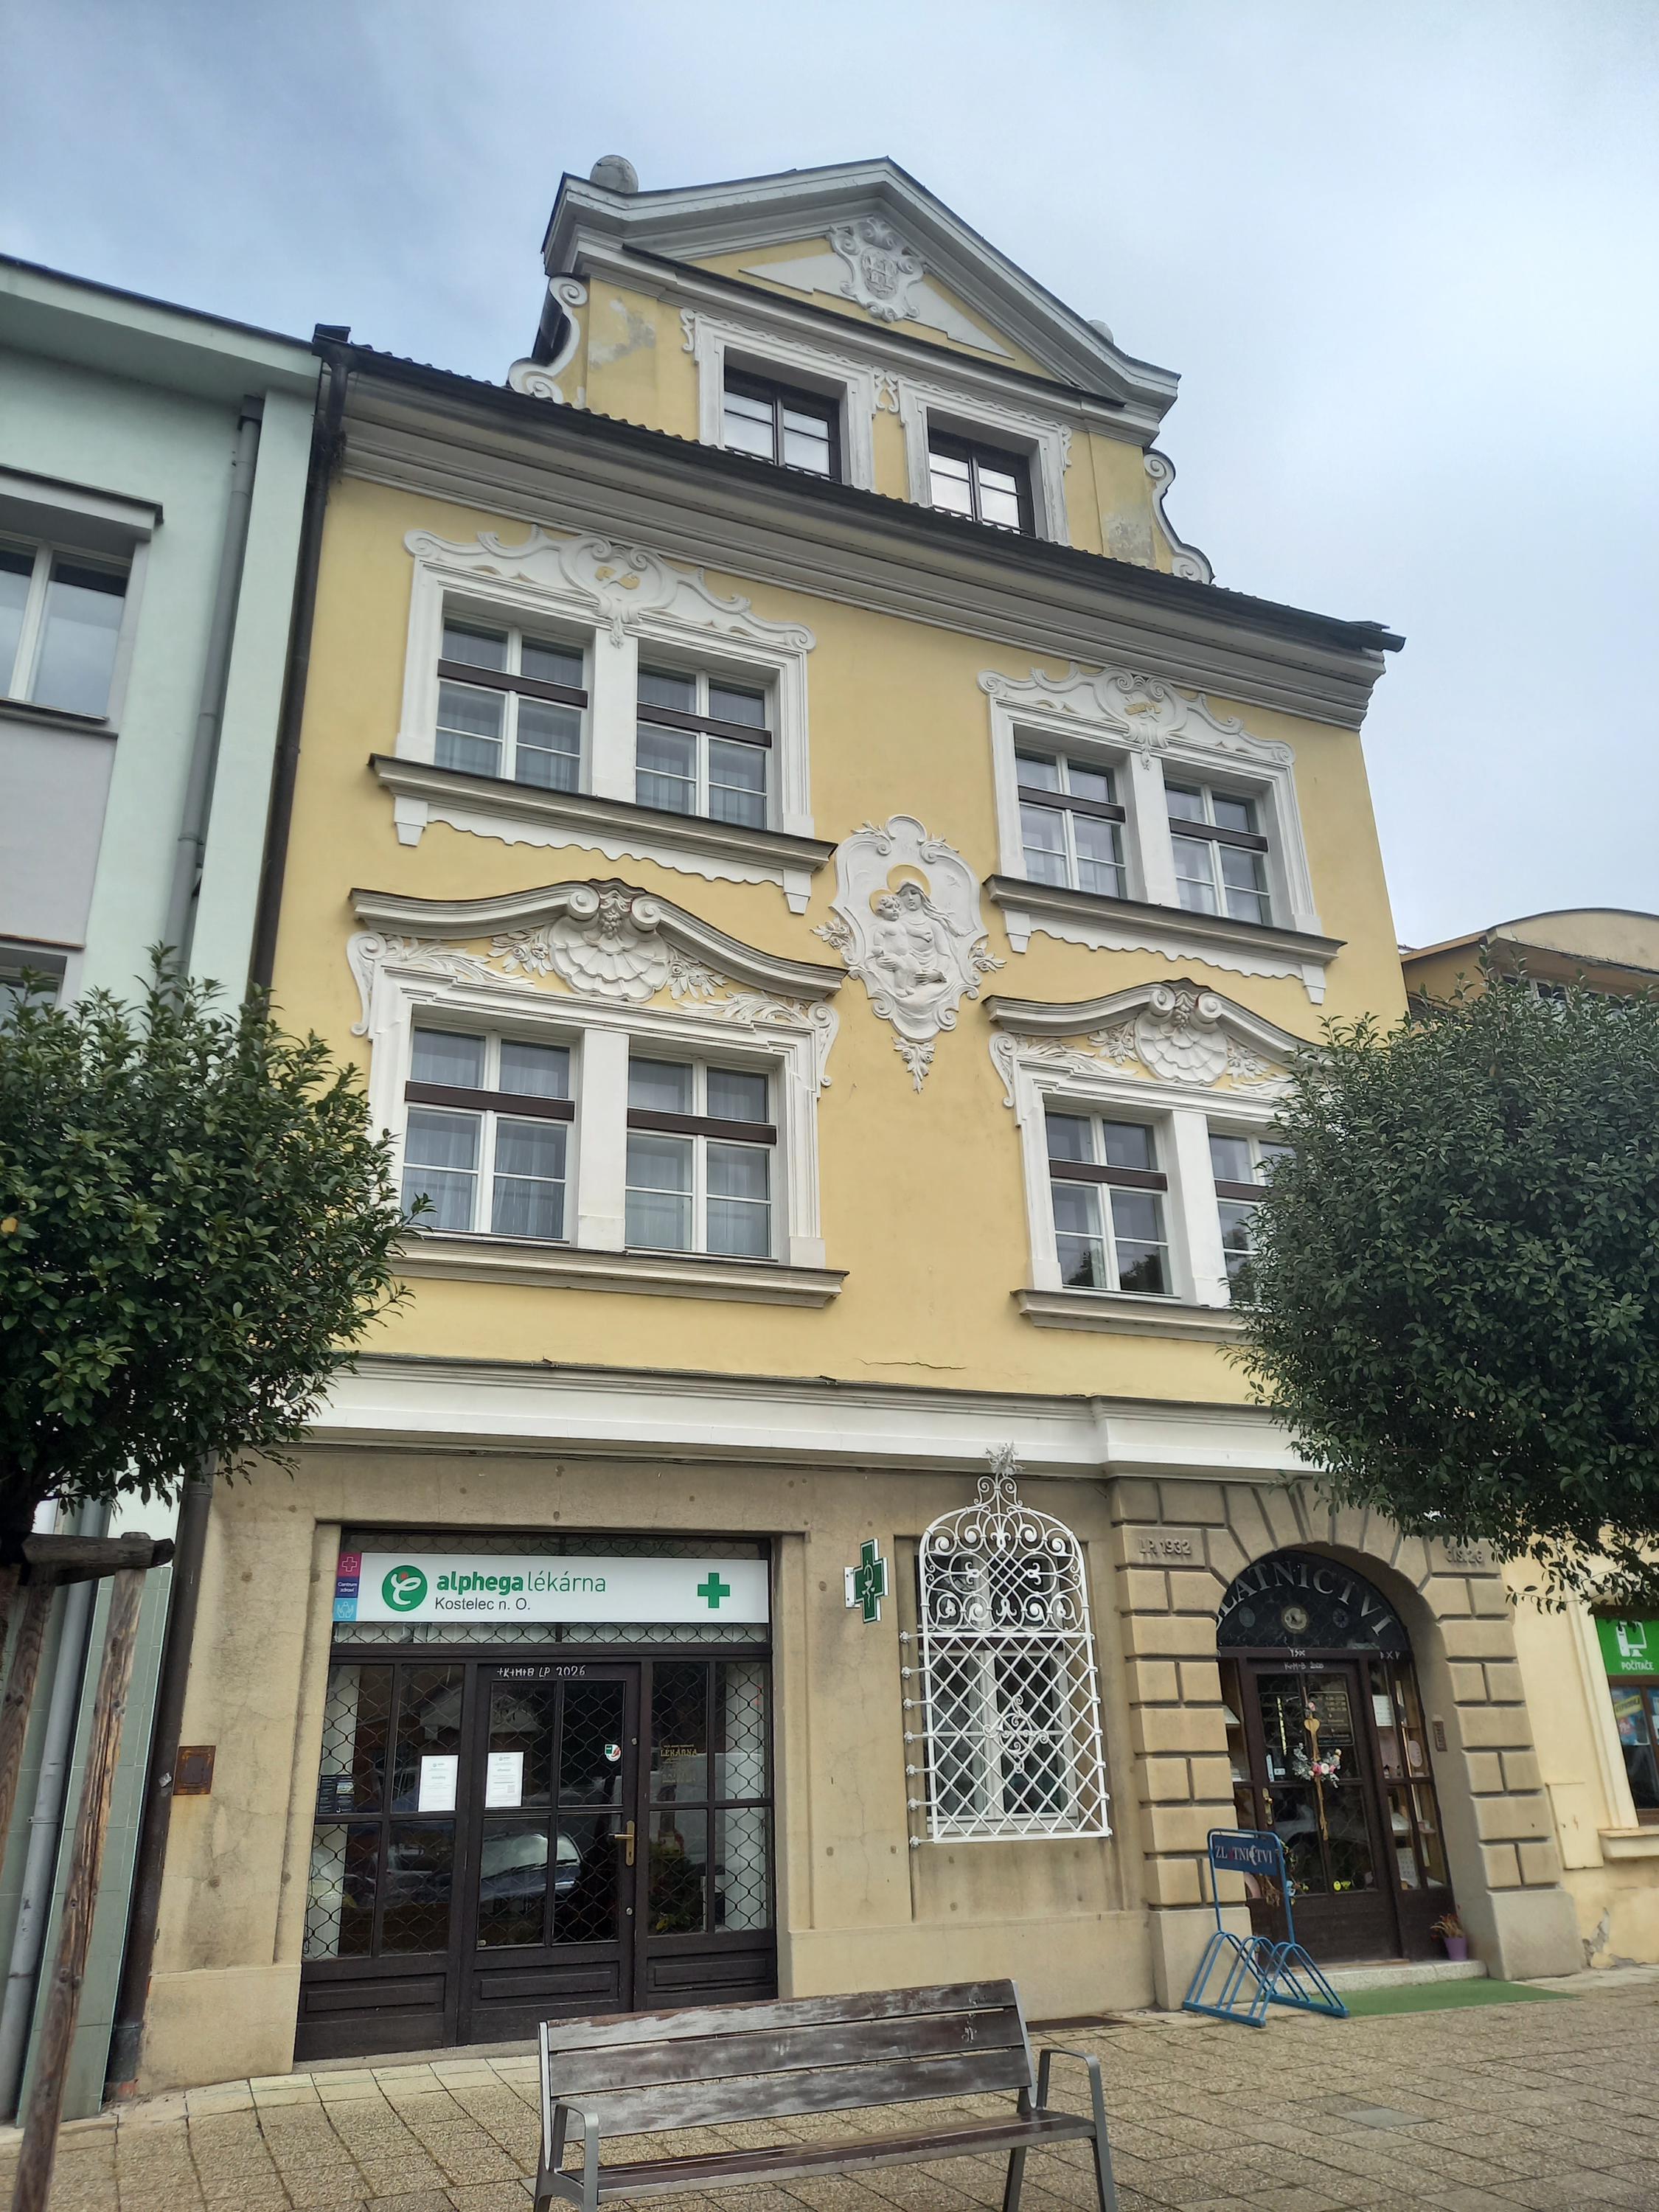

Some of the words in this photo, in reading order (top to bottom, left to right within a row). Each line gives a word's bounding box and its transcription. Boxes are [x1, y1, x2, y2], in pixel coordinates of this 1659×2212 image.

[1159, 1538, 1192, 1555] 1932
[437, 1571, 524, 1596] alphega
[527, 1570, 606, 1593] lékárna
[435, 1596, 495, 1610] Kostelec
[498, 1600, 510, 1610] n.
[515, 1597, 531, 1610] O.
[538, 1666, 551, 1678] LP
[555, 1664, 587, 1677] 2026
